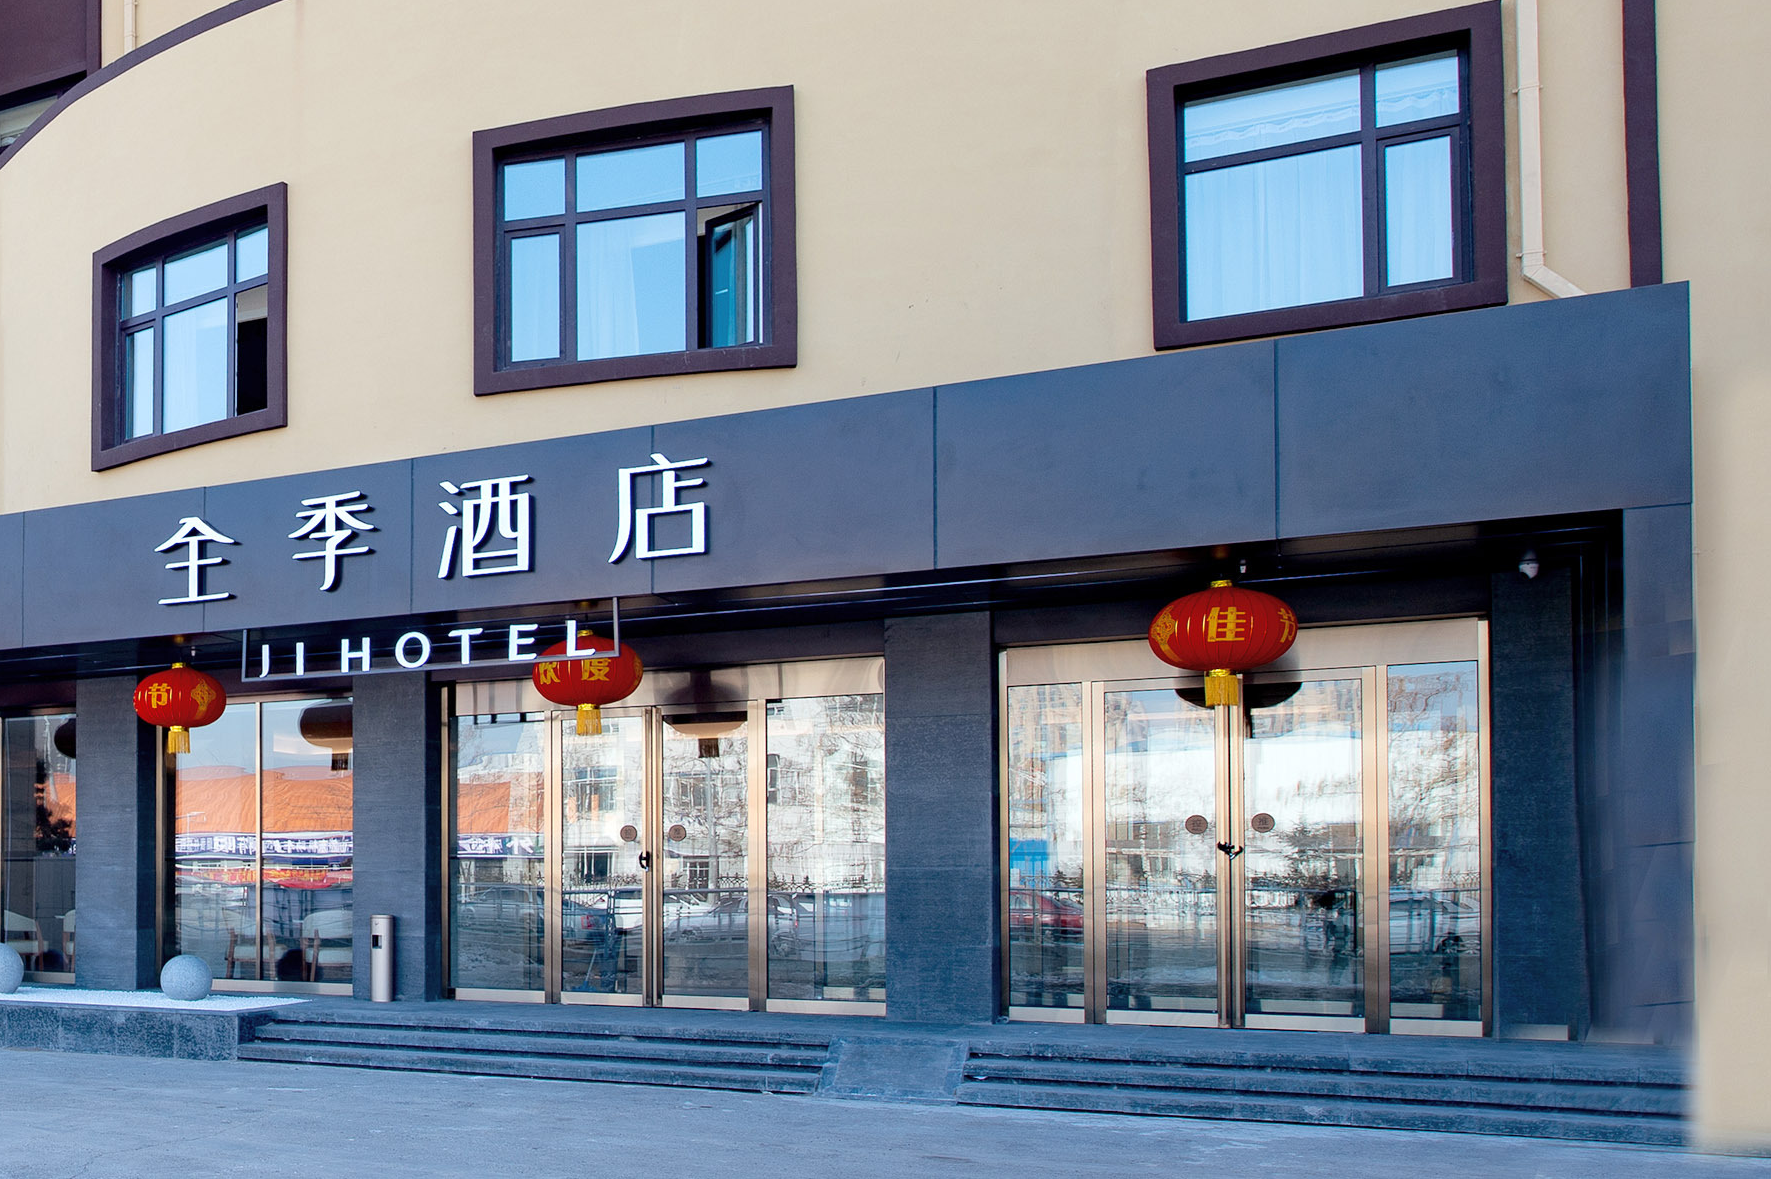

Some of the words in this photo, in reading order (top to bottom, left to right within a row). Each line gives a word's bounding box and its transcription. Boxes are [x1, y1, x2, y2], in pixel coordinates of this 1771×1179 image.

[154, 453, 709, 606] 全季酒店
[259, 641, 305, 678] JI
[340, 619, 596, 673] HOTEL
[148, 683, 171, 709] 节
